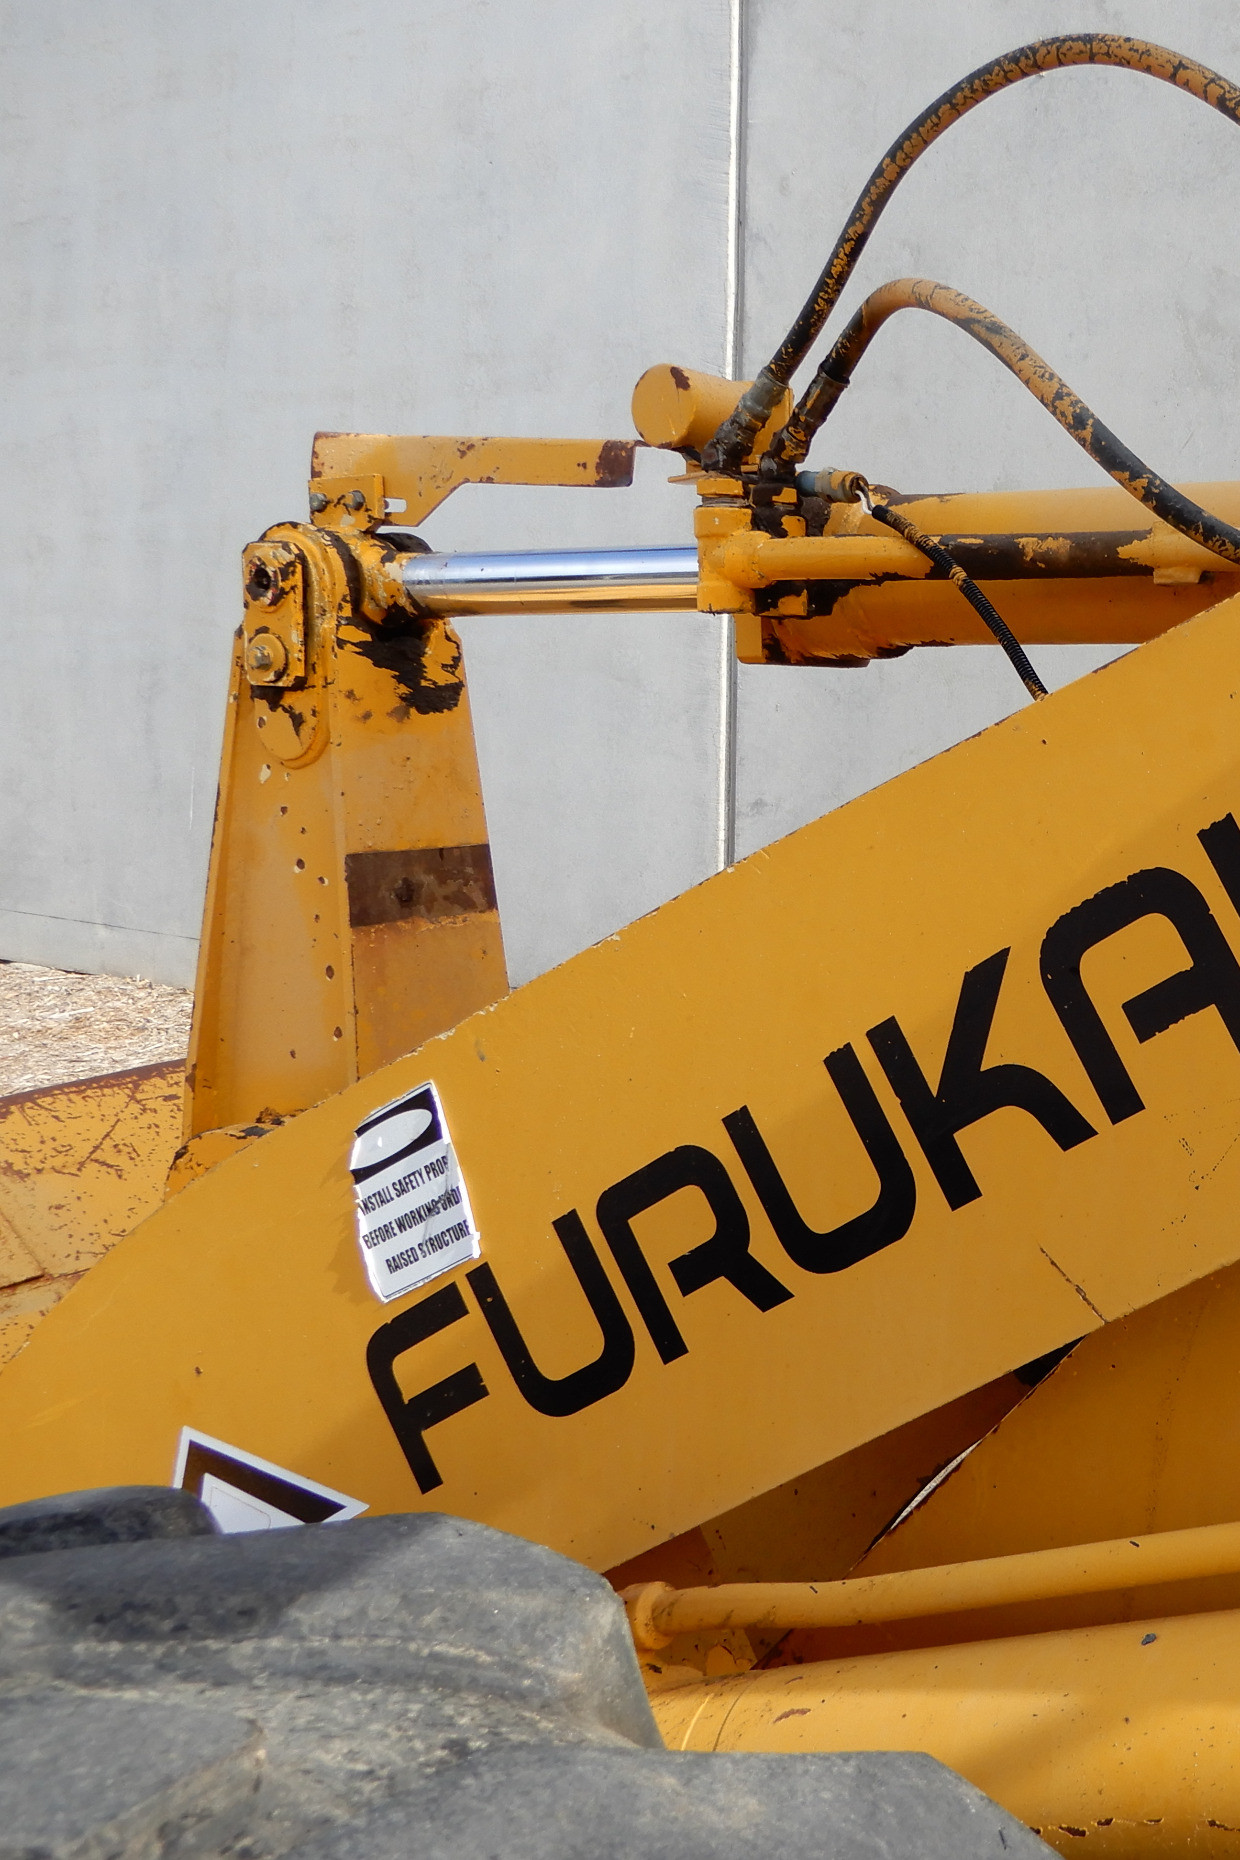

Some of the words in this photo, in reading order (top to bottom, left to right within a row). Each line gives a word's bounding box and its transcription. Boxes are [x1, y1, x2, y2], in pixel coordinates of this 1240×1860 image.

[392, 1168, 425, 1198] SAFETY
[362, 1221, 397, 1249] BEFORE
[394, 1199, 441, 1234] WORKING
[385, 1247, 419, 1274] RAISED
